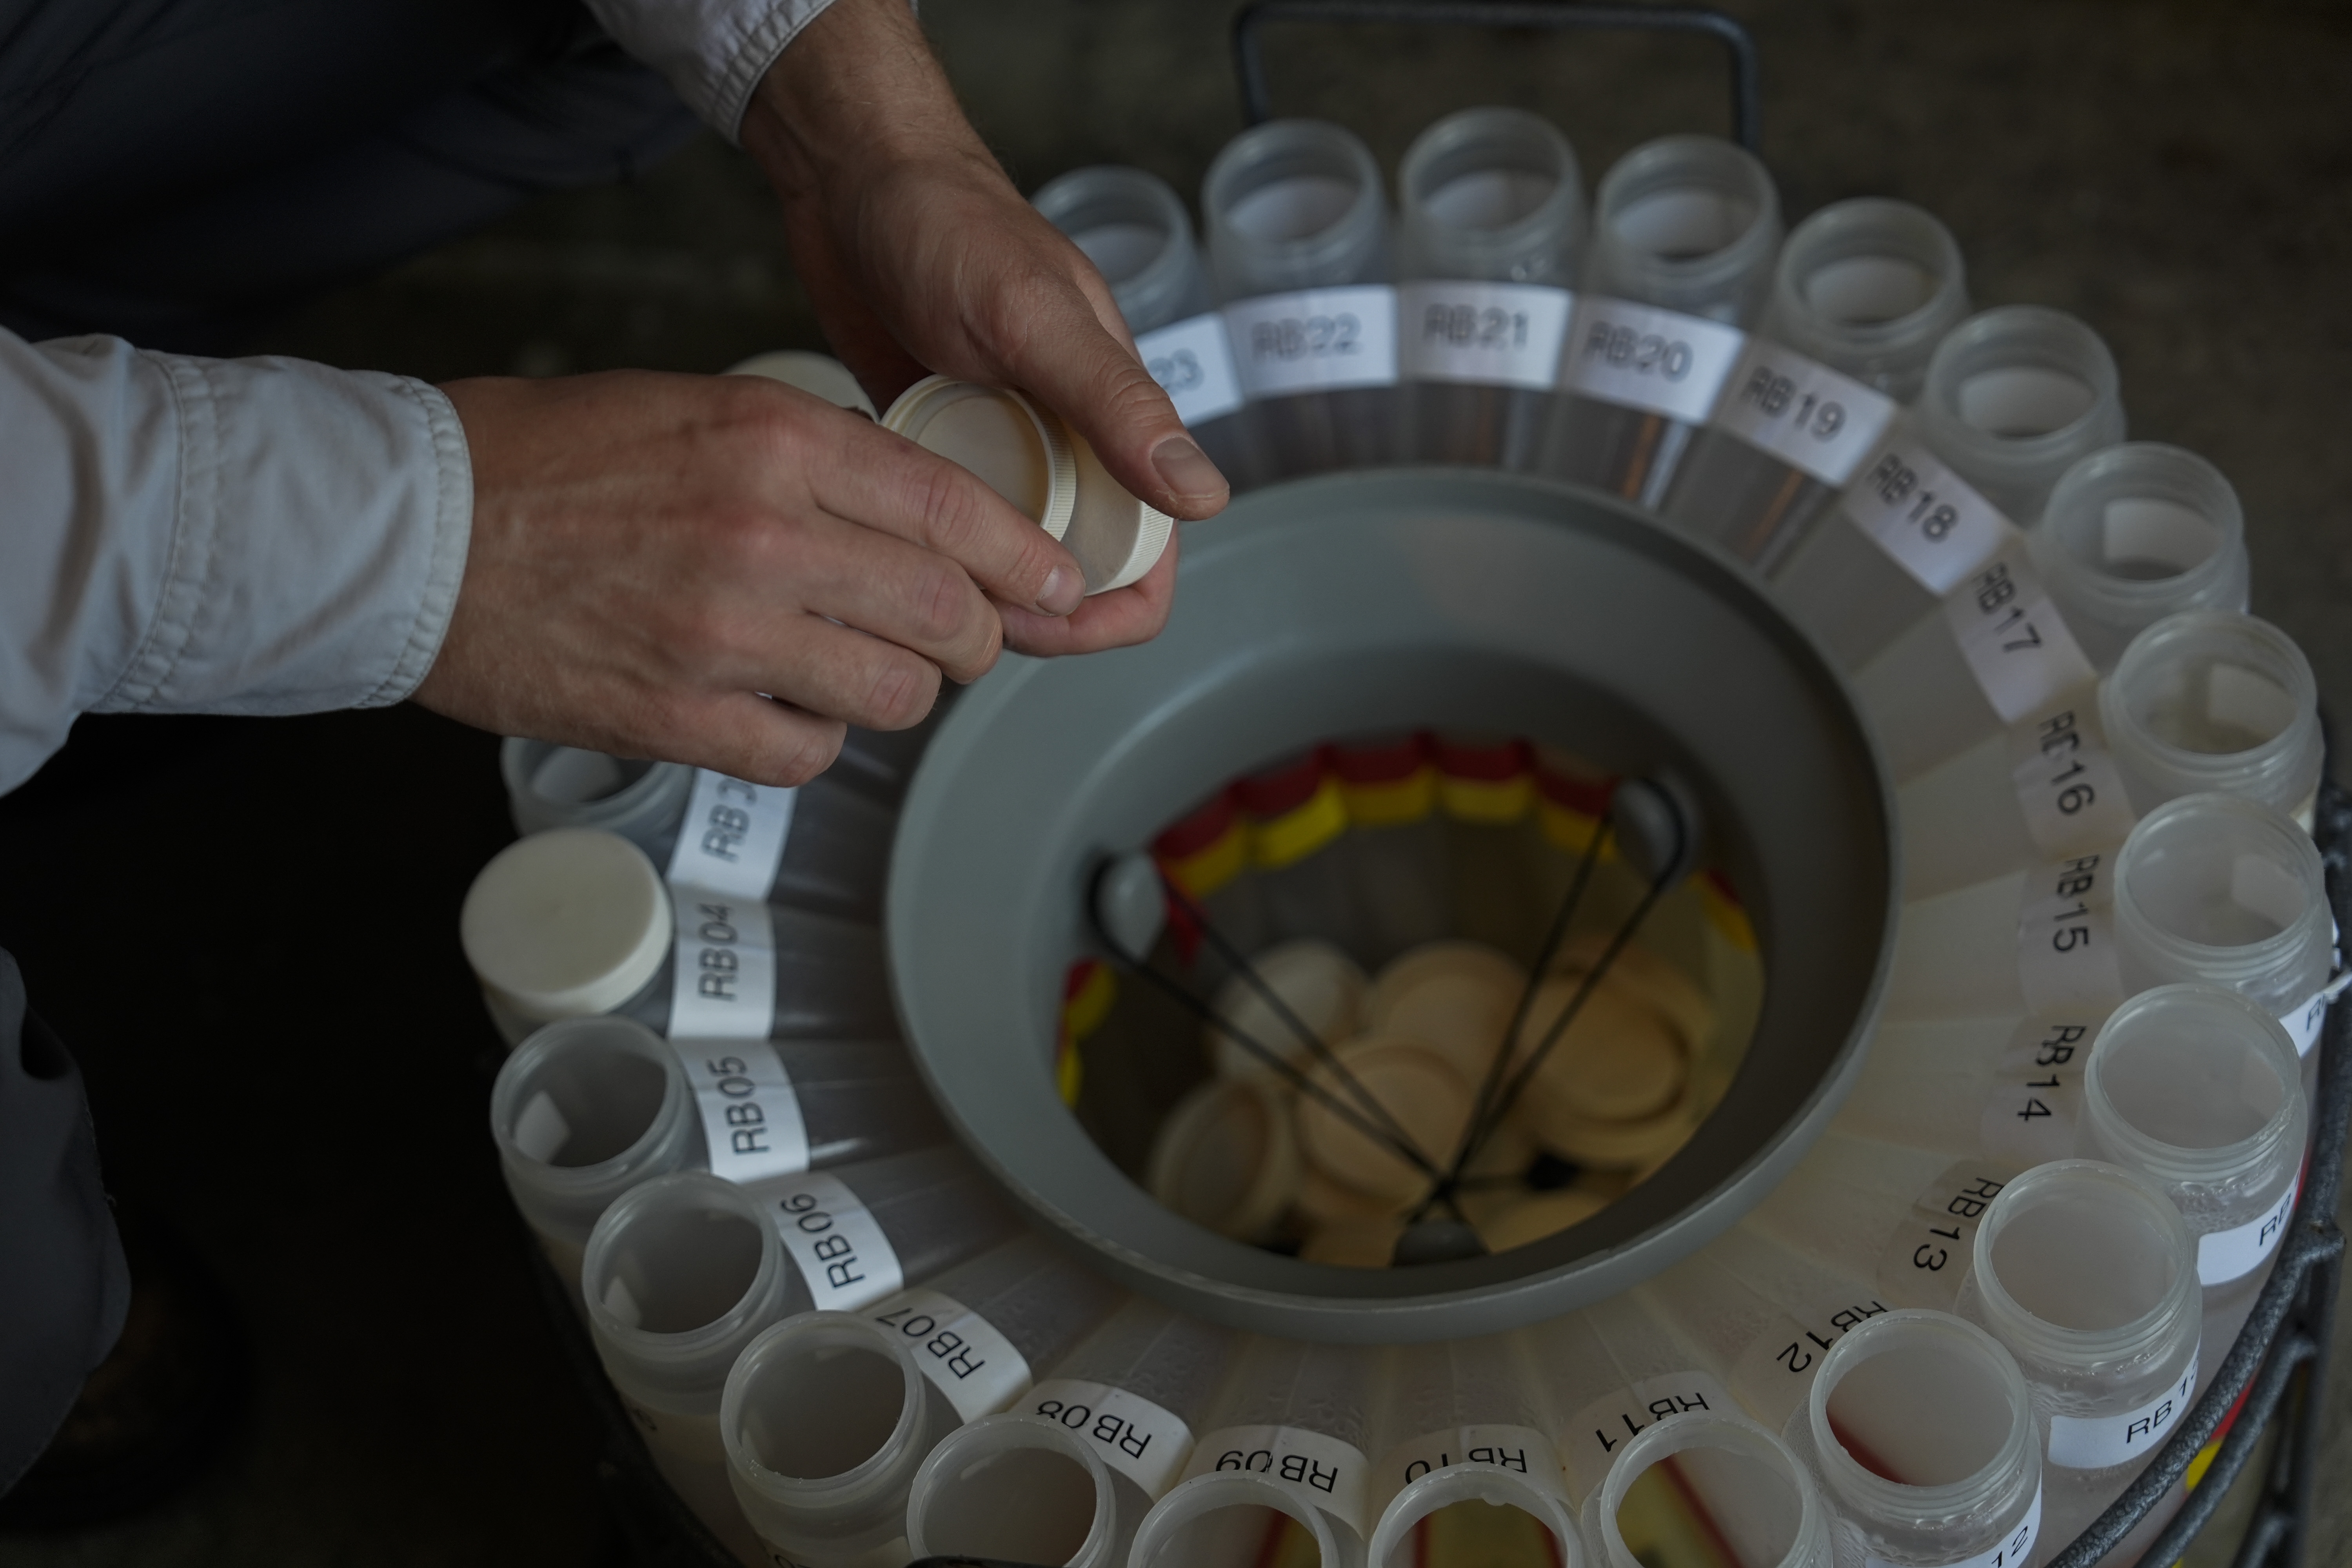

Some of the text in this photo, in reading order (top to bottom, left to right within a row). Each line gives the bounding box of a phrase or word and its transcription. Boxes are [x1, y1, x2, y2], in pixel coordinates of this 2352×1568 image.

[1255, 314, 1360, 361] RB22
[1423, 302, 1527, 350] RB21
[1582, 319, 1693, 382] RB20
[1741, 365, 1847, 442] RB19
[1867, 453, 1958, 544] RB18
[1972, 563, 2041, 653] RB17
[700, 778, 759, 862] RB0
[2053, 855, 2099, 953] RB15
[699, 903, 738, 1002] RB04
[707, 1055, 770, 1156] RB05
[2017, 1025, 2087, 1122] RB14
[779, 1192, 866, 1290] RB06
[1913, 1177, 2005, 1271] RB13
[875, 1307, 986, 1379] RB07
[1776, 1301, 1889, 1372] RB12
[1036, 1400, 1152, 1459] RB08
[1596, 1392, 1710, 1452] RB11
[1216, 1450, 1338, 1493] RB09
[1991, 1526, 2028, 1568] 12
